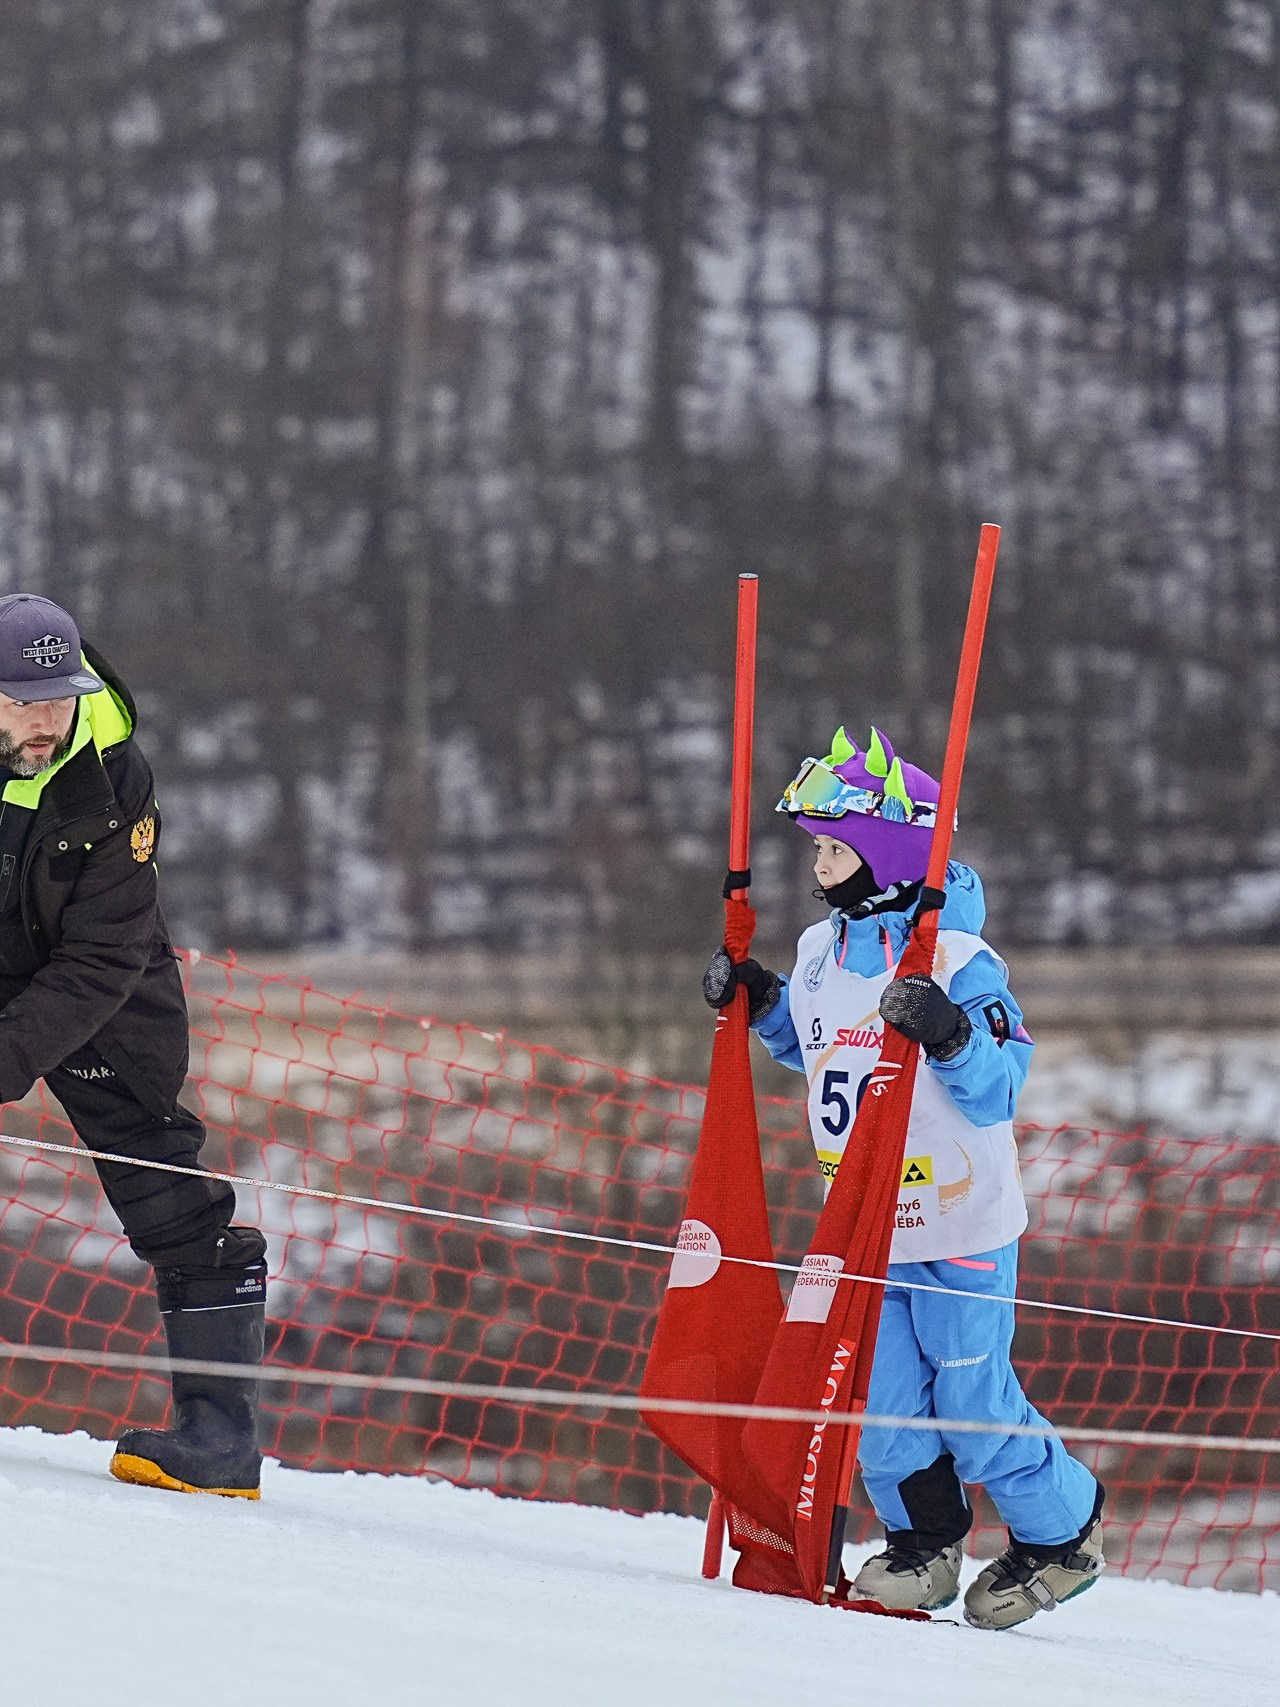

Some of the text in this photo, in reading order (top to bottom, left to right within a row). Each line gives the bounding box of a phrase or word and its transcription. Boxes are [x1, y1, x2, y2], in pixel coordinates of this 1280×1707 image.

[23, 649, 38, 657] WEST
[904, 977, 932, 989] winter
[894, 1215, 925, 1228] ЁВА
[796, 1343, 852, 1518] MOSCOW
